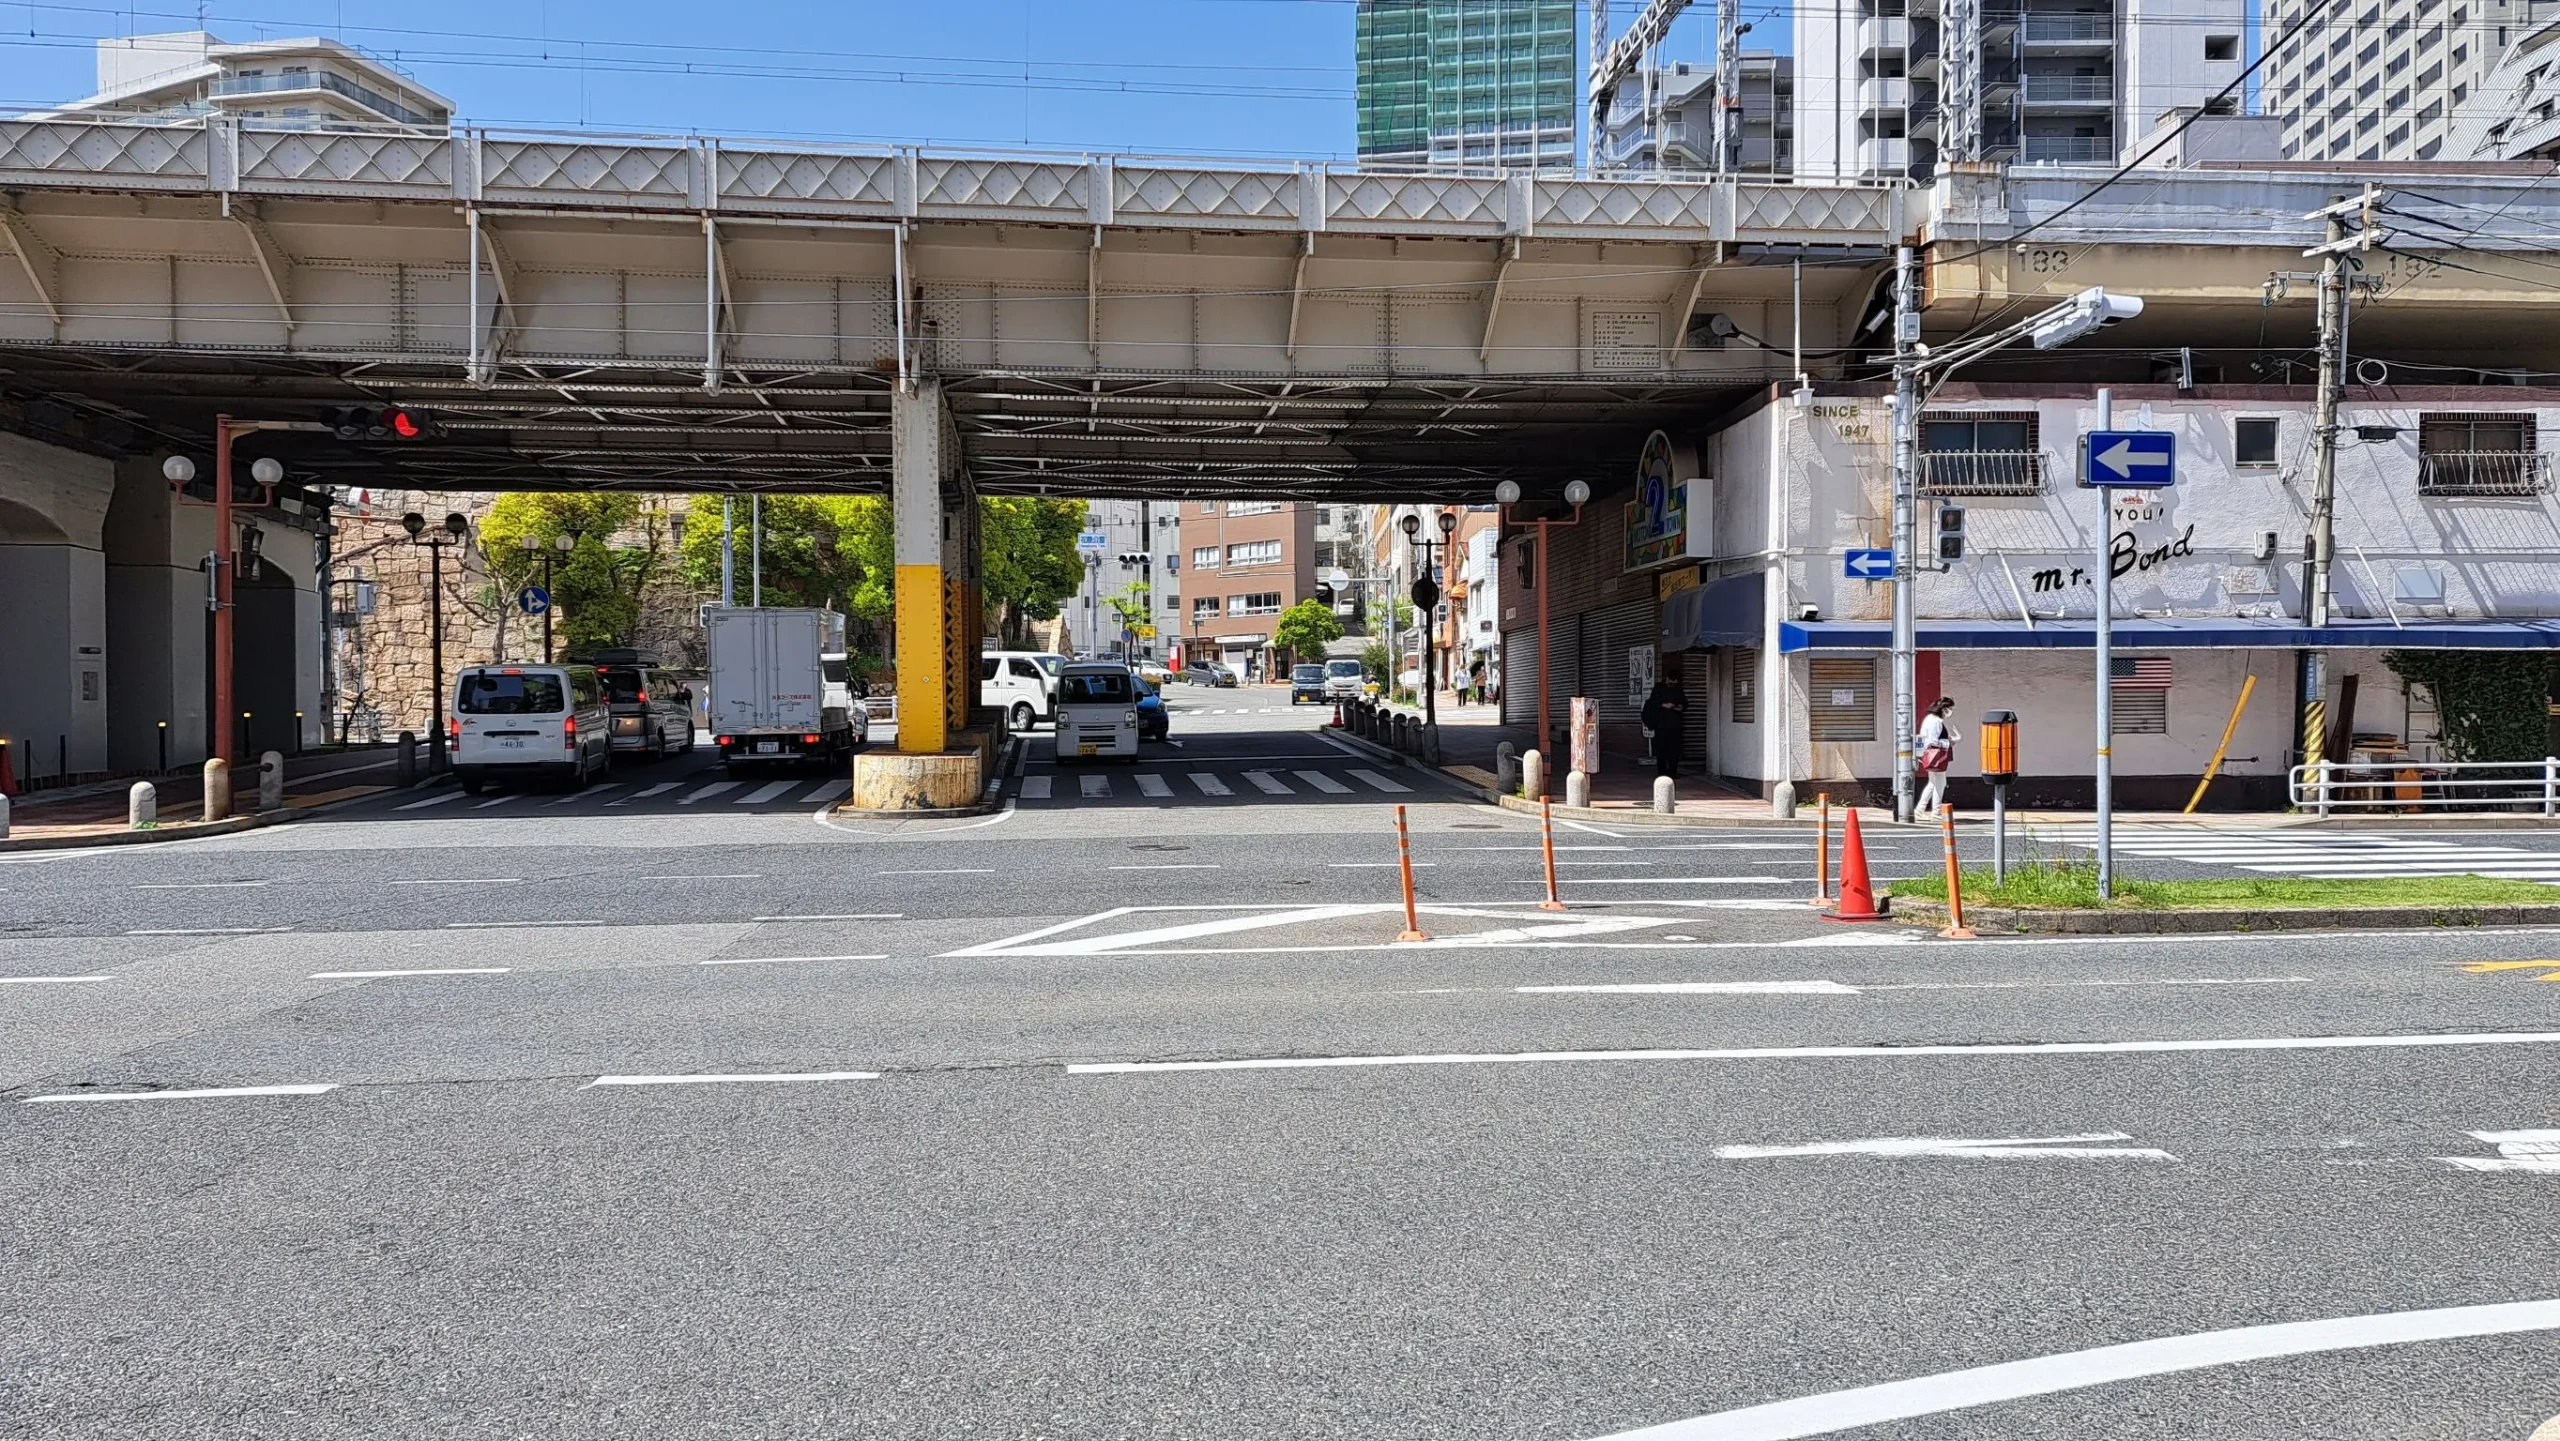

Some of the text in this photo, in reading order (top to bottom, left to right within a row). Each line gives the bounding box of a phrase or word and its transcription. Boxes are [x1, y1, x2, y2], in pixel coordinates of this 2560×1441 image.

[2018, 250, 2068, 273] 183
[2389, 255, 2442, 278] 182
[1812, 405, 1859, 417] SINCE
[1838, 425, 1870, 437] 1947
[1666, 514, 1681, 533] TOWN
[2114, 507, 2164, 521] YOU!
[2110, 524, 2194, 580] Bond
